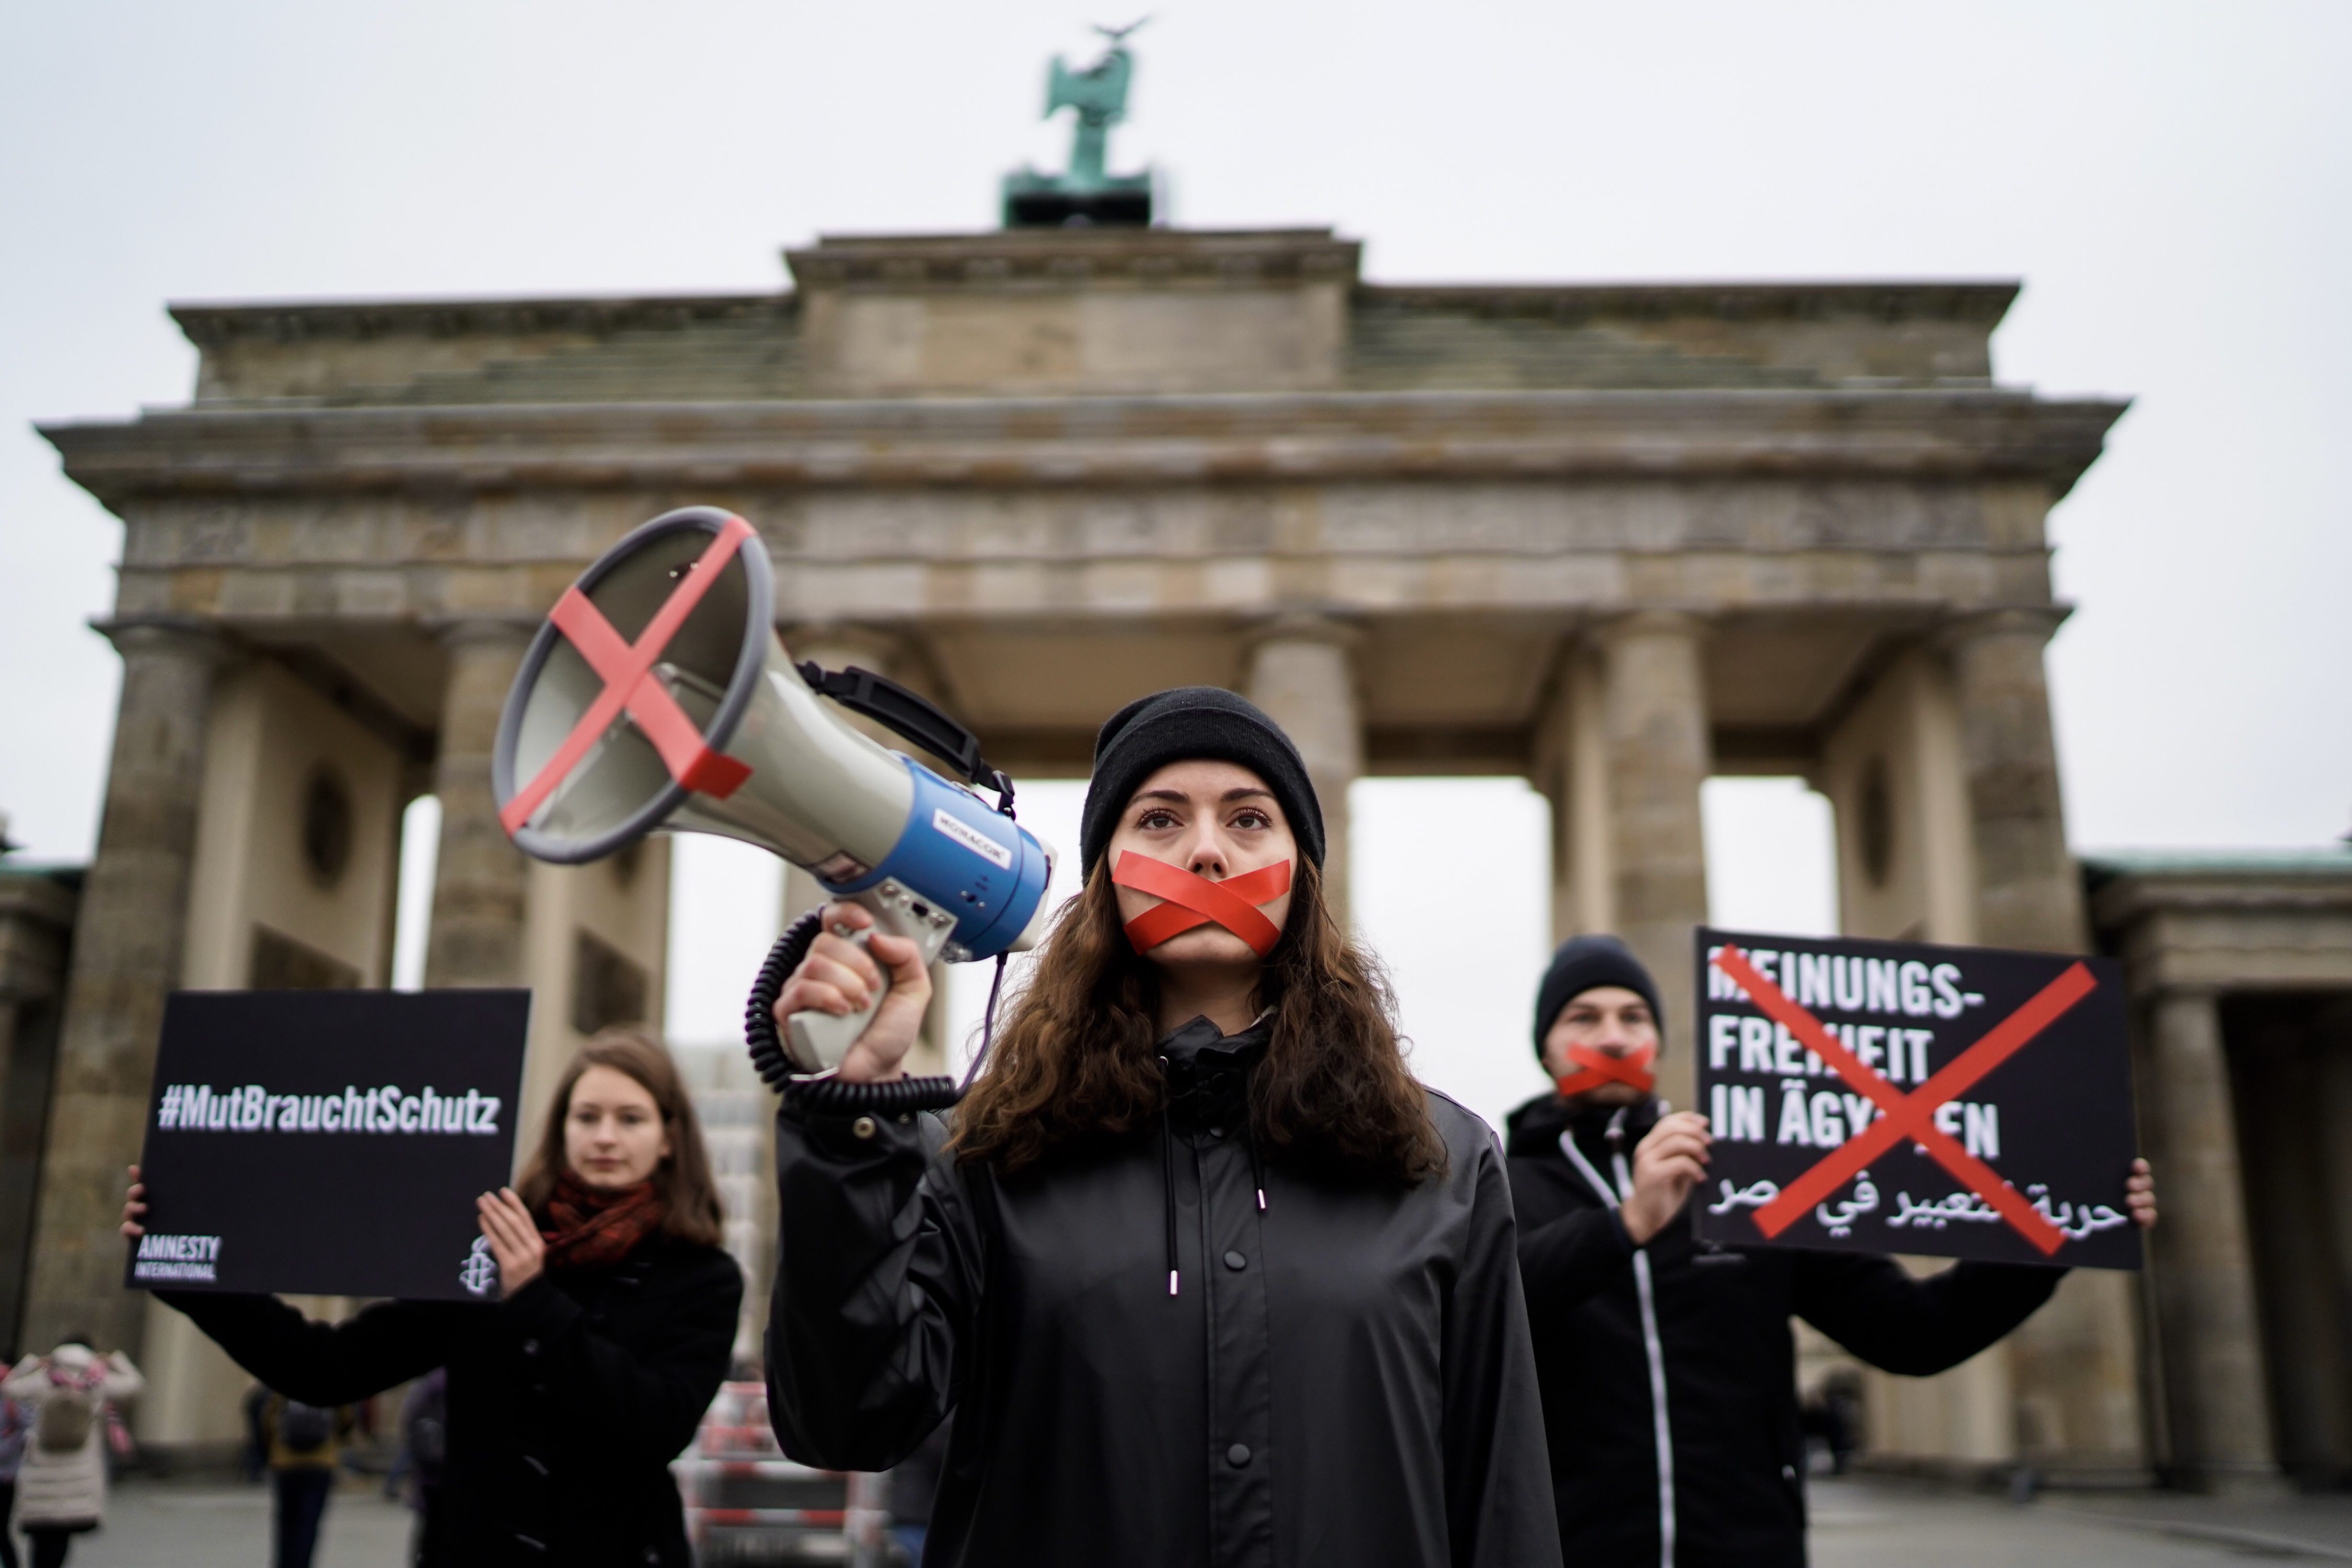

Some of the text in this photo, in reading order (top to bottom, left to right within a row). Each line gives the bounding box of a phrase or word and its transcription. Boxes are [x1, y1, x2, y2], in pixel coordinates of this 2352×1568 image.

[158, 1083, 502, 1134] #MutBrauchtSchutz
[1710, 1078, 2001, 1159] IN ÄGYEN
[1707, 1177, 1781, 1215] صر
[1816, 1169, 1881, 1238] في
[137, 1234, 222, 1261] AMNESTY
[134, 1261, 217, 1281] INTERNATIONAL
